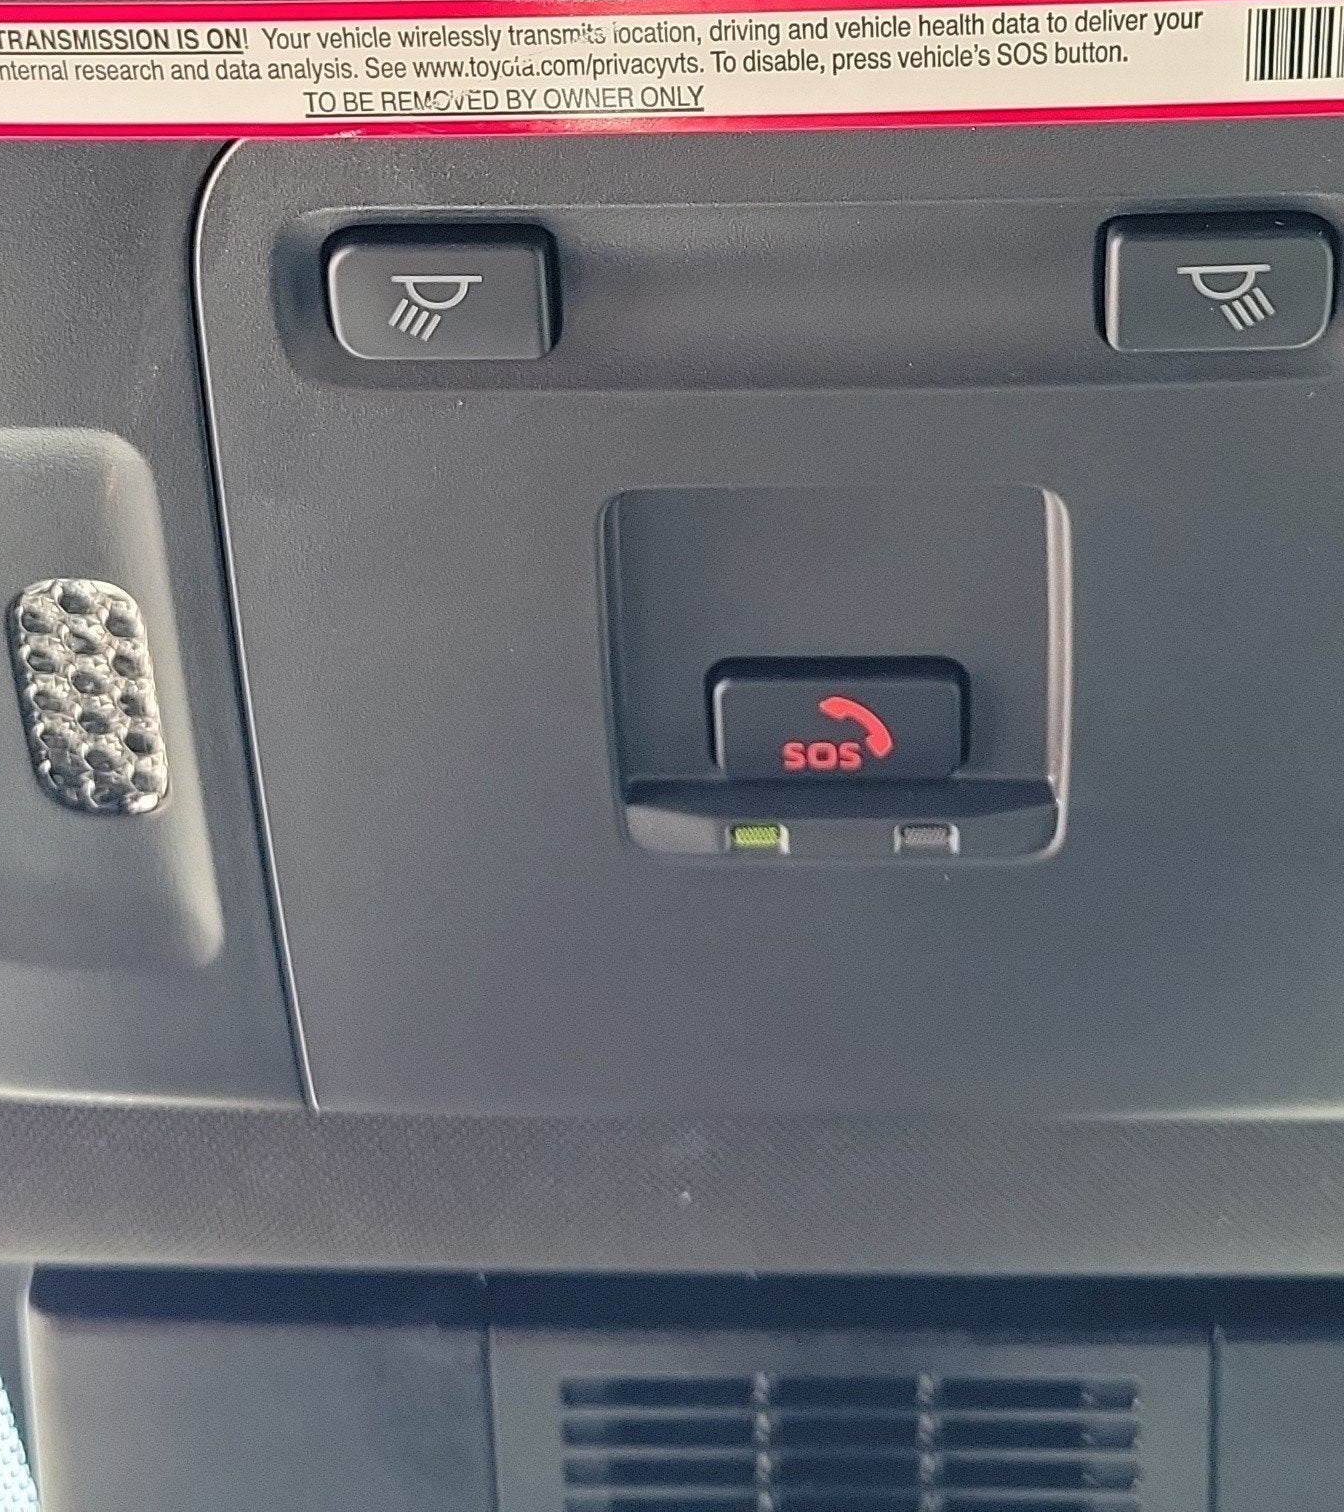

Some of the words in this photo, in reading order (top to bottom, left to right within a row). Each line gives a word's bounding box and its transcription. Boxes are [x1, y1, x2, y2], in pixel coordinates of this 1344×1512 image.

[177, 29, 199, 50] IS
[206, 28, 249, 49] ON!
[263, 28, 311, 49] Your
[317, 27, 391, 49] vehicle
[398, 26, 502, 52] wirelessly
[710, 19, 780, 46] driving
[788, 17, 828, 39] and
[836, 15, 911, 38] vehicle
[918, 13, 984, 36] health
[992, 13, 1040, 35] data
[1047, 13, 1067, 33] to
[1074, 10, 1147, 33] deliver
[1154, 12, 1203, 35] your
[75, 61, 164, 81] research
[171, 61, 208, 81] and
[216, 61, 262, 80] data
[268, 59, 358, 84] analysis.
[365, 58, 407, 78] See
[710, 51, 736, 73] To
[743, 48, 825, 74] disable,
[832, 49, 891, 75] press
[997, 43, 1047, 65] SOS
[1054, 41, 1128, 63] button.
[303, 92, 336, 113] TO
[344, 92, 374, 112] BE
[506, 90, 537, 109] BY
[544, 87, 634, 109] OWNER
[640, 86, 704, 108] ONLY
[782, 740, 863, 771] SOS
